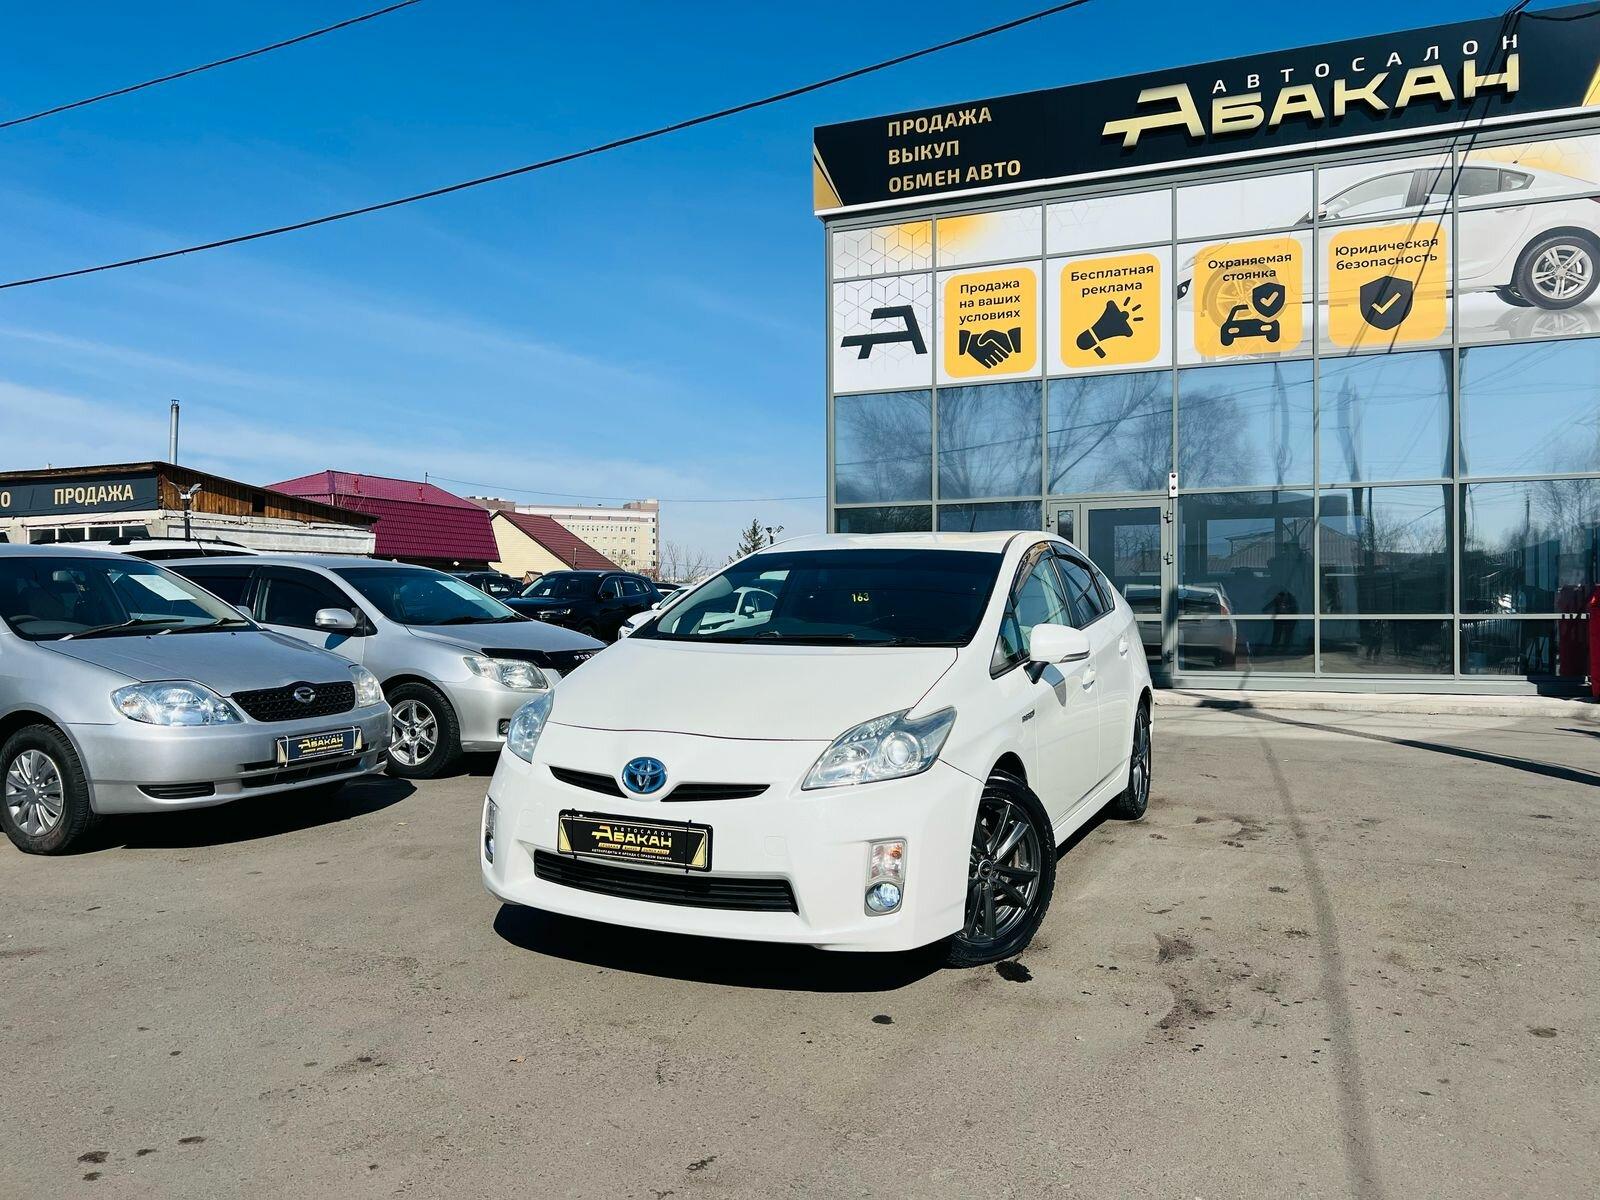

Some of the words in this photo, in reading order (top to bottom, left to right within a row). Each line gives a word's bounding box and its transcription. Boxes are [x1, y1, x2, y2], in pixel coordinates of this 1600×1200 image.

[1212, 34, 1519, 94] АВТОСАЛОН
[888, 106, 992, 137] ПРОДАЖА
[888, 140, 960, 165] ВЫКУП
[888, 168, 960, 193] ОБМЕН
[965, 159, 1022, 183] АВТО
[1335, 238, 1439, 256] Юридическая
[1207, 253, 1293, 270] Охраняемая
[1336, 253, 1438, 271] безопасность
[1070, 263, 1155, 282] Бесплатная
[1222, 268, 1277, 282] стоянка
[959, 279, 1020, 295] Продажа
[1081, 280, 1143, 297] реклама
[959, 298, 974, 308] на
[978, 294, 1021, 307] ваших
[958, 309, 1021, 326] условиях
[54, 484, 134, 506] ПРОДАЖА
